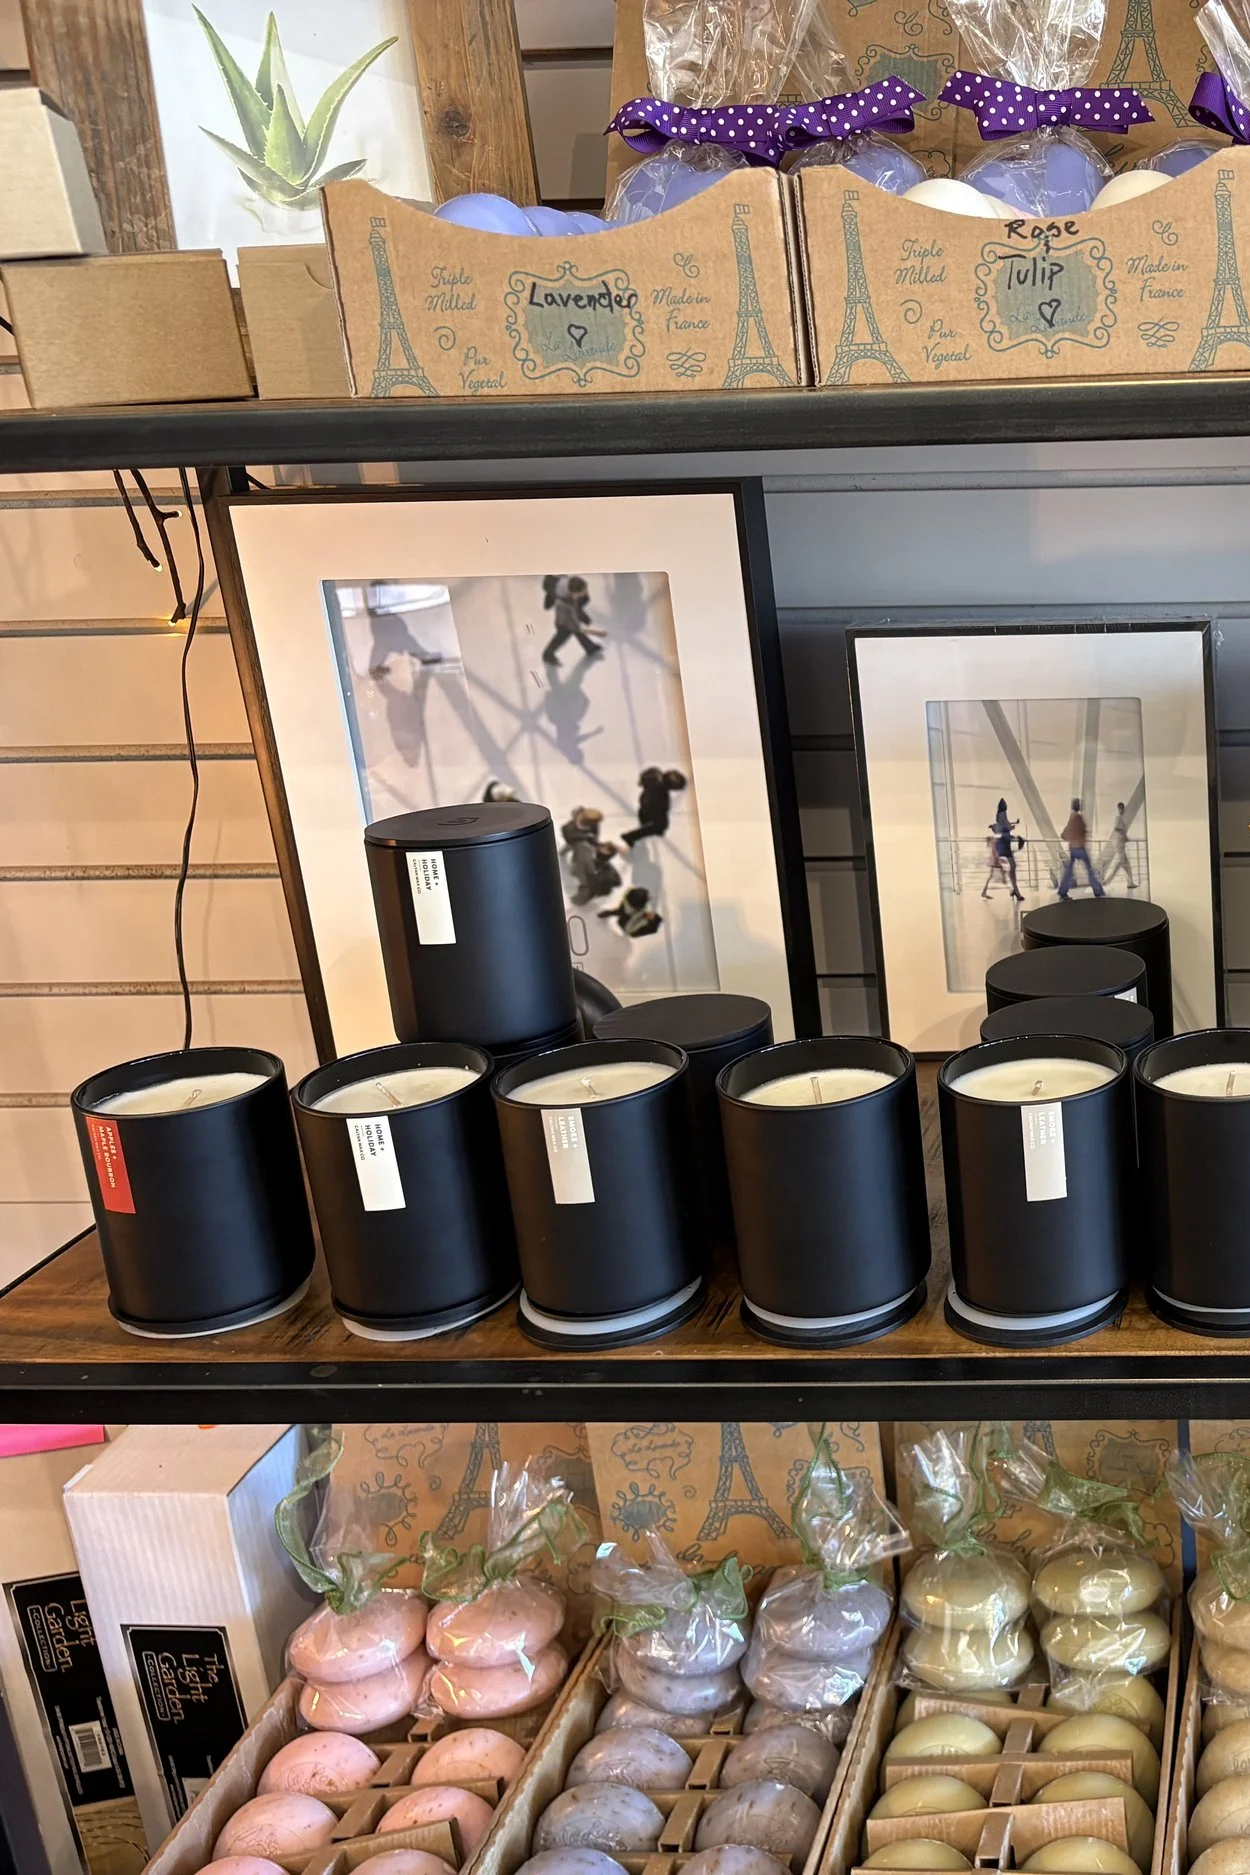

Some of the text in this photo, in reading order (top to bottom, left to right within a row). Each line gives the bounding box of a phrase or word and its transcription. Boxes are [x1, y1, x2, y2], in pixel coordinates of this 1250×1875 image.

[1004, 218, 1080, 239] Rose
[902, 238, 945, 264] Triple
[1126, 254, 1188, 274] Made in
[431, 266, 472, 291] Triple
[895, 266, 948, 286] Milled
[998, 253, 1064, 291] Tulip
[425, 292, 477, 312] Milled
[528, 280, 638, 313] Lavender
[652, 286, 711, 306] Made in
[1139, 277, 1185, 302] France
[665, 308, 710, 333] France
[928, 318, 957, 340] Pur
[463, 346, 491, 366] Pur
[922, 345, 973, 370] Vegetal
[459, 371, 507, 396] Vegetal
[421, 859, 432, 891] HOLIDAY
[431, 858, 440, 880] HOME
[106, 1126, 117, 1154] APPLES
[365, 1124, 377, 1157] HOLIDAY
[375, 1123, 385, 1146] HOME
[558, 1116, 569, 1149] LEATHER
[568, 1116, 578, 1142] SMOKE
[1038, 1112, 1047, 1145] LEATHER
[98, 1126, 116, 1188] MAPLE BOURBON
[65, 1600, 97, 1648] Light
[33, 1610, 51, 1665] COLLECTION
[44, 1602, 74, 1673] Garden
[177, 1653, 209, 1704] Light
[202, 1651, 225, 1684] The
[147, 1659, 166, 1715] COLLECTION
[158, 1651, 186, 1724] Garden
